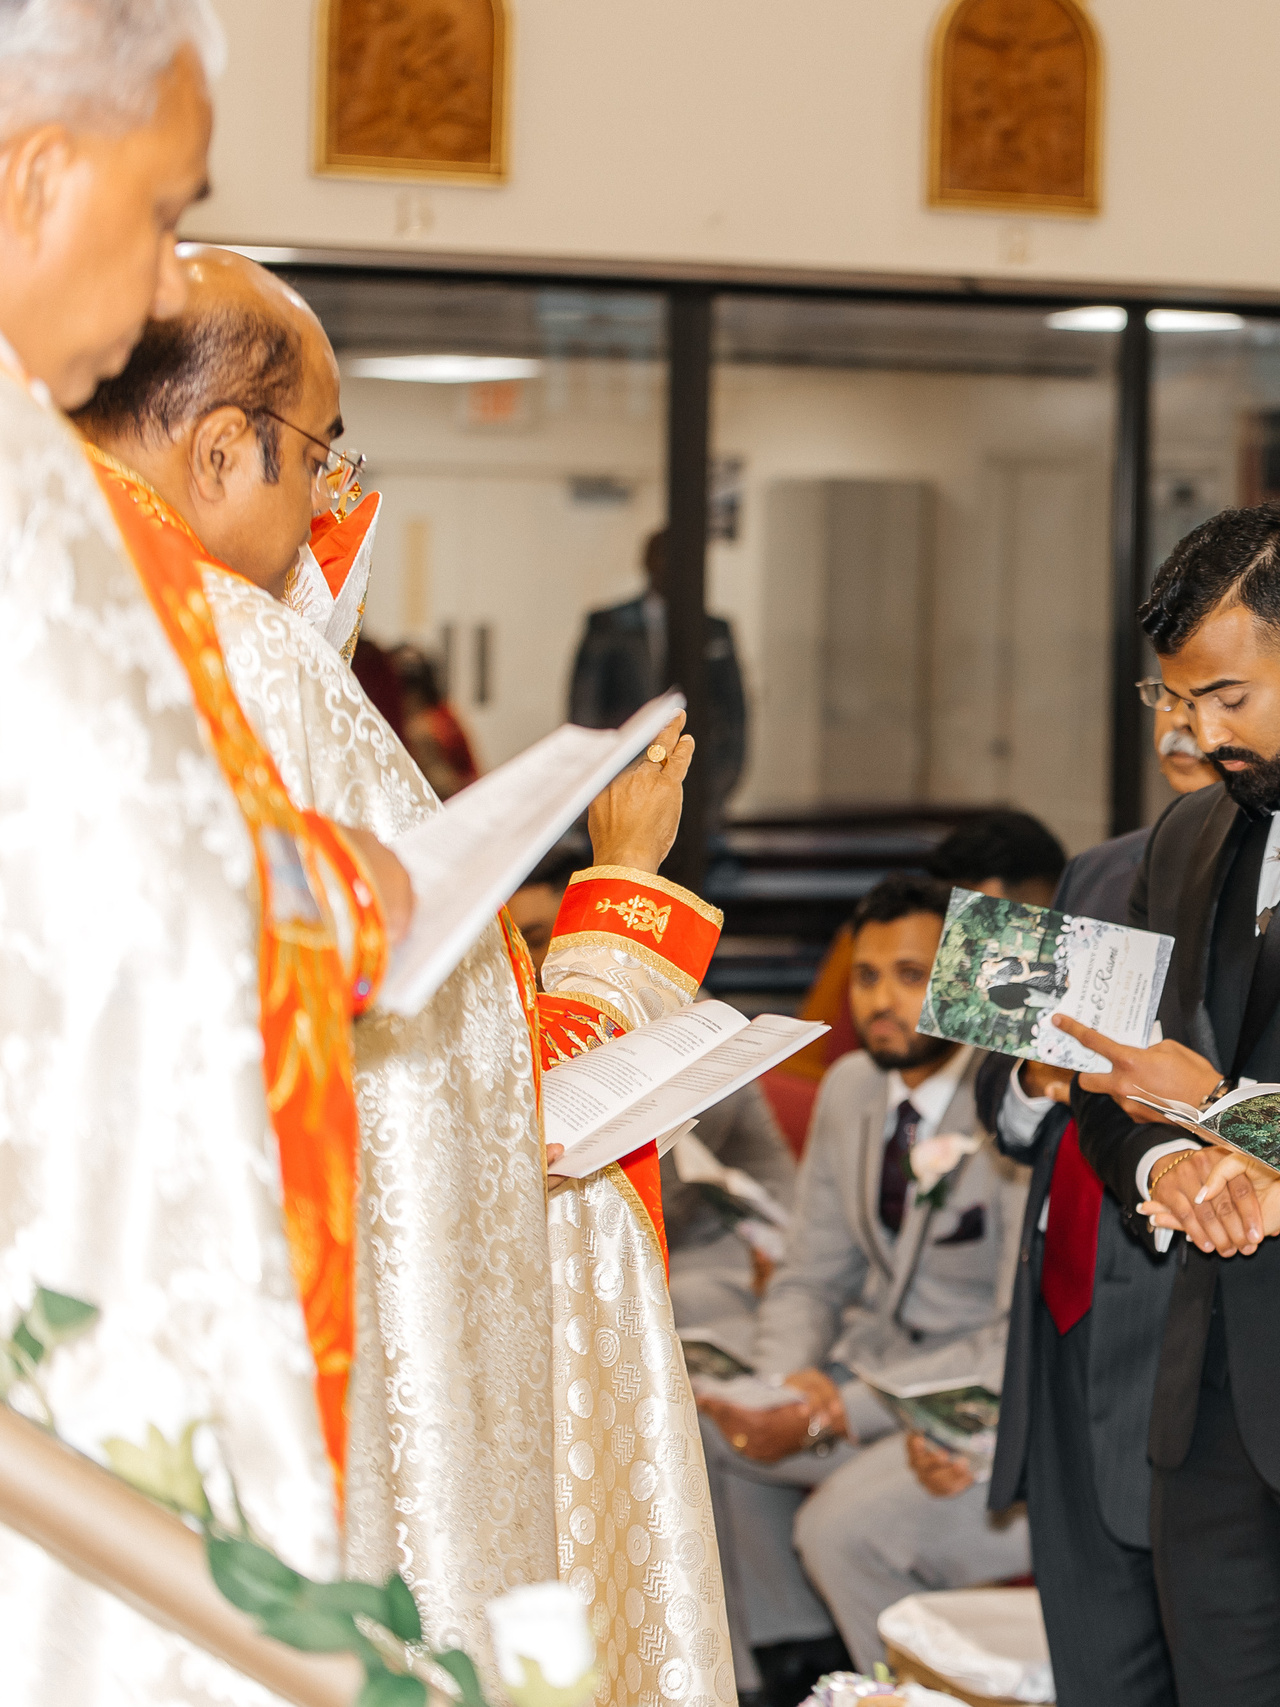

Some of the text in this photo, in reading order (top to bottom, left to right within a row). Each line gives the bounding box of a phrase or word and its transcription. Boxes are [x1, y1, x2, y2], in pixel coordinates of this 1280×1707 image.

[1075, 1001, 1084, 1020] OLY
[1080, 952, 1096, 1001] MATRIMONY
[1091, 994, 1106, 1011] &
